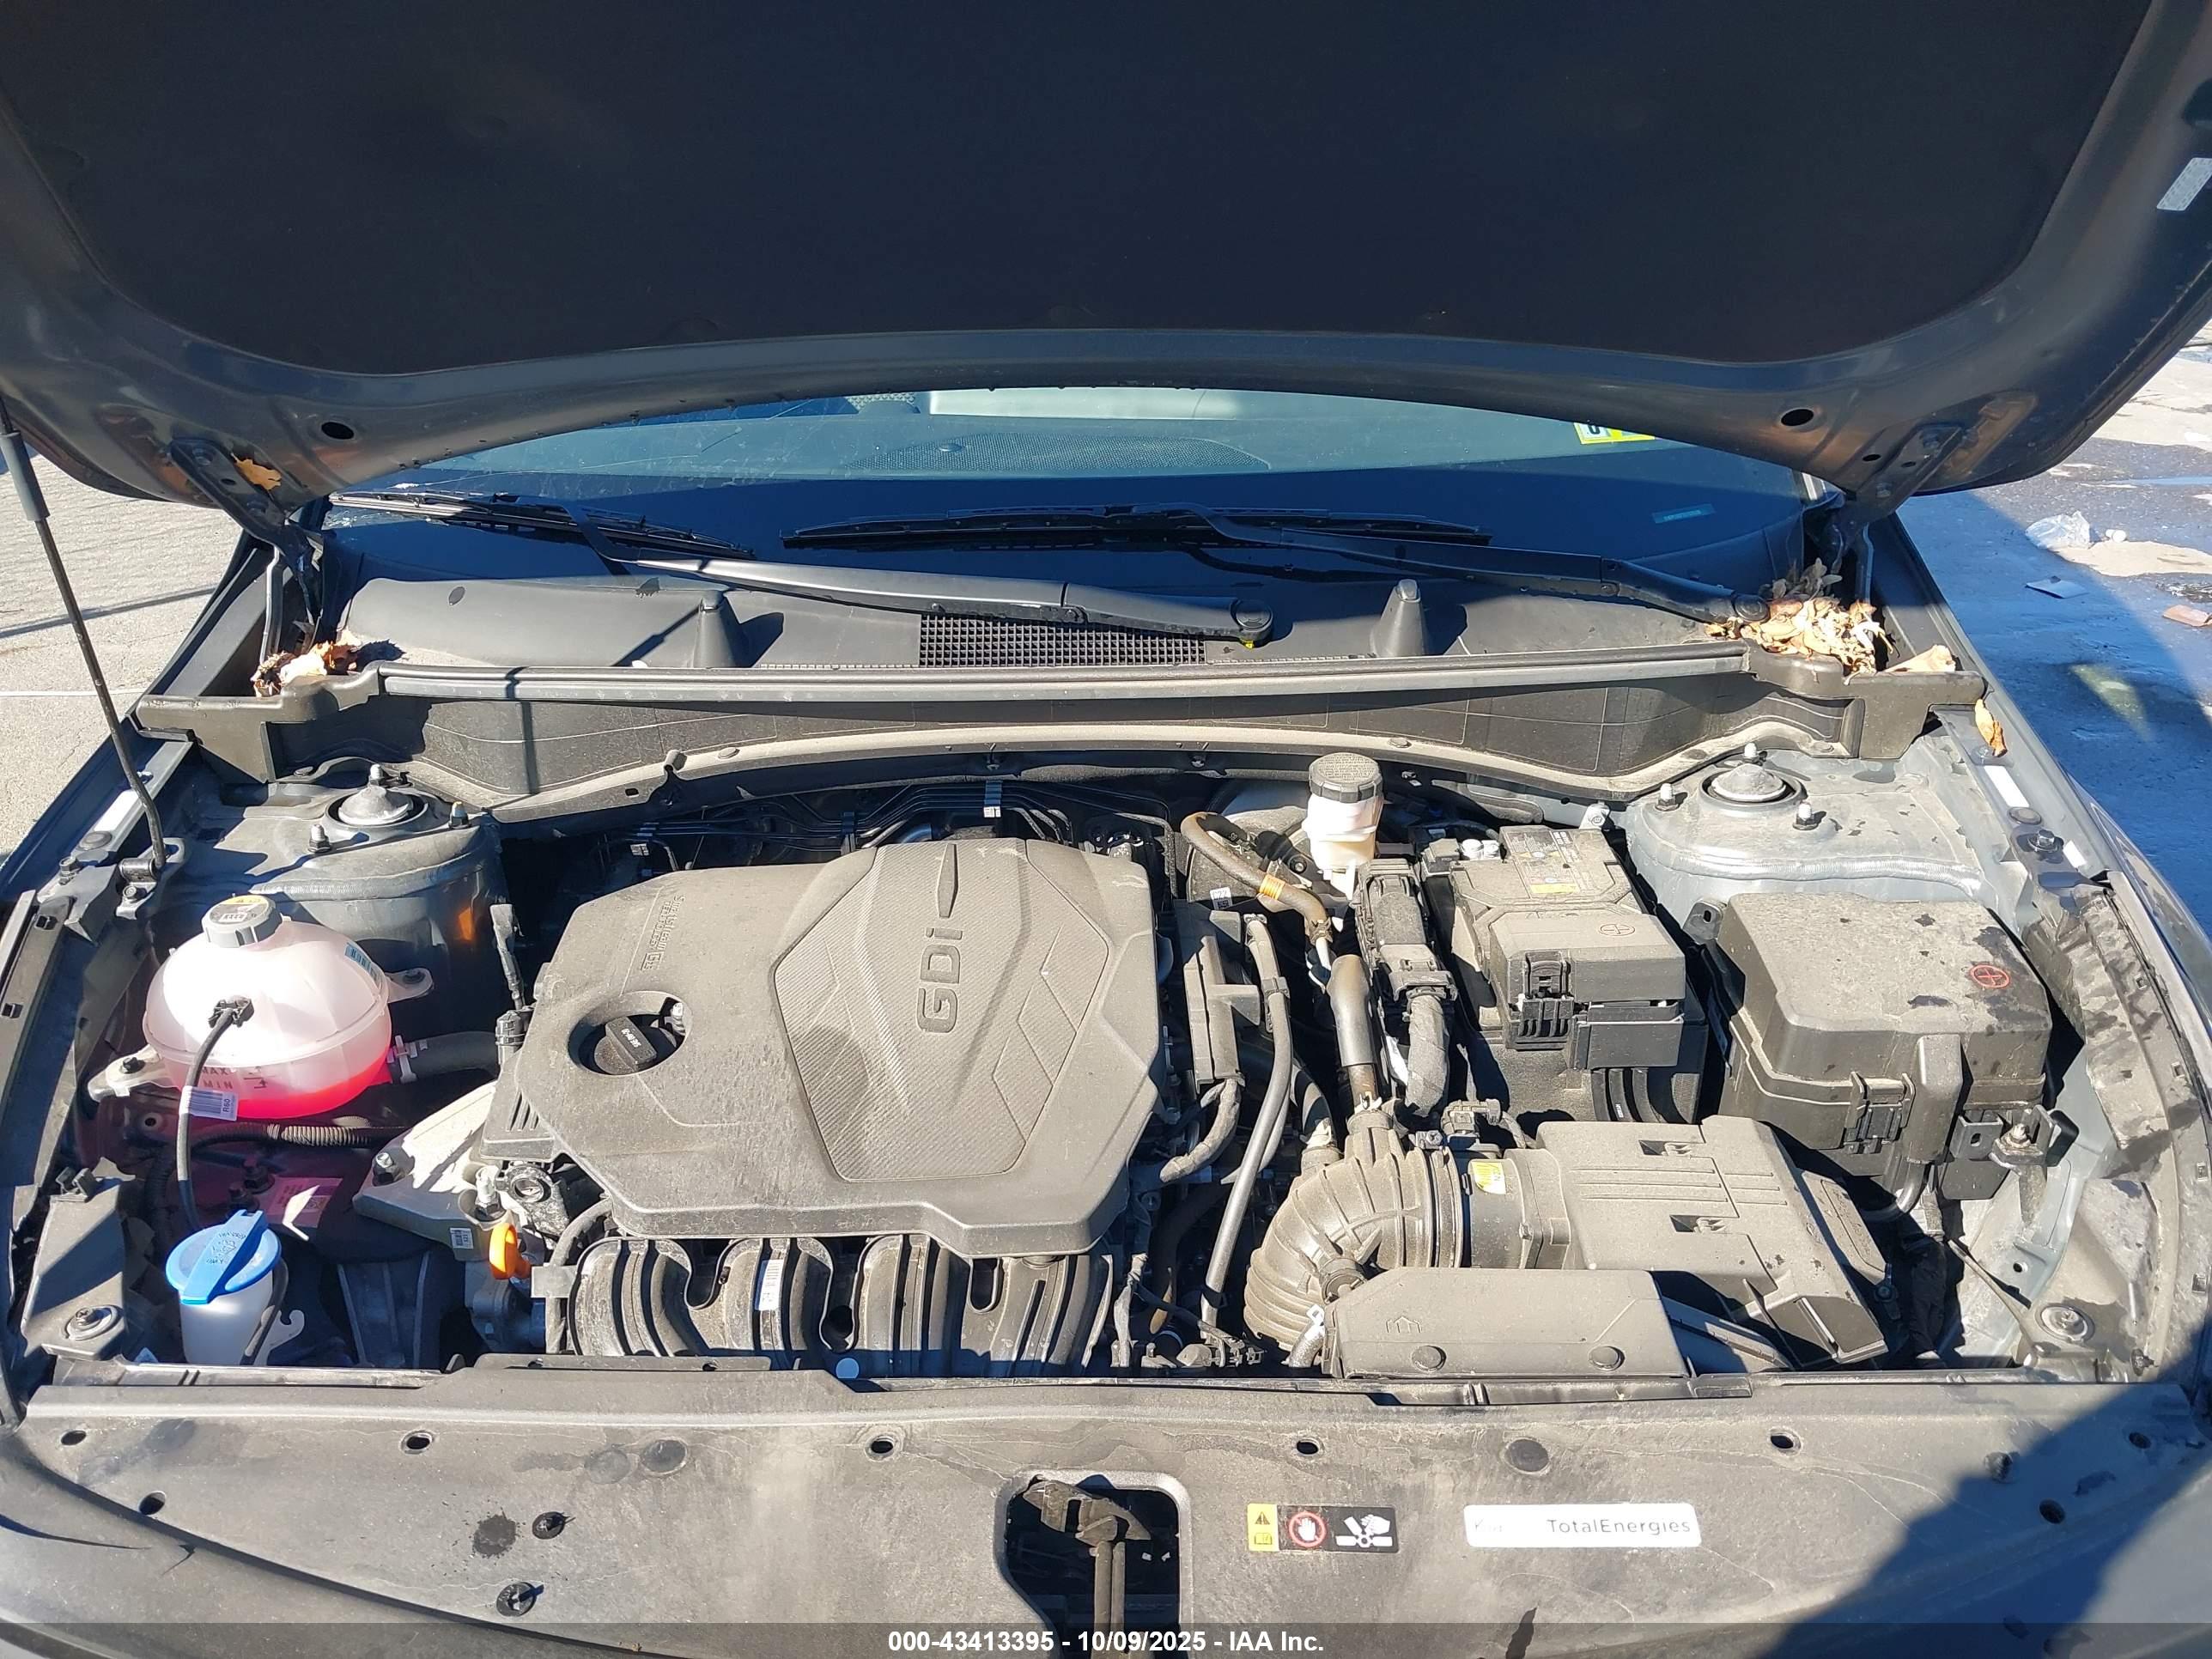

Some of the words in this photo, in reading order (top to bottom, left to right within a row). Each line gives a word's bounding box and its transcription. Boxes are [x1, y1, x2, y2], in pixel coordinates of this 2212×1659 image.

[657, 893, 686, 951] Smartstream
[201, 1066, 228, 1076] MAX
[204, 1079, 234, 1090] MIN
[1546, 1518, 1691, 1536] TotalEnergies
